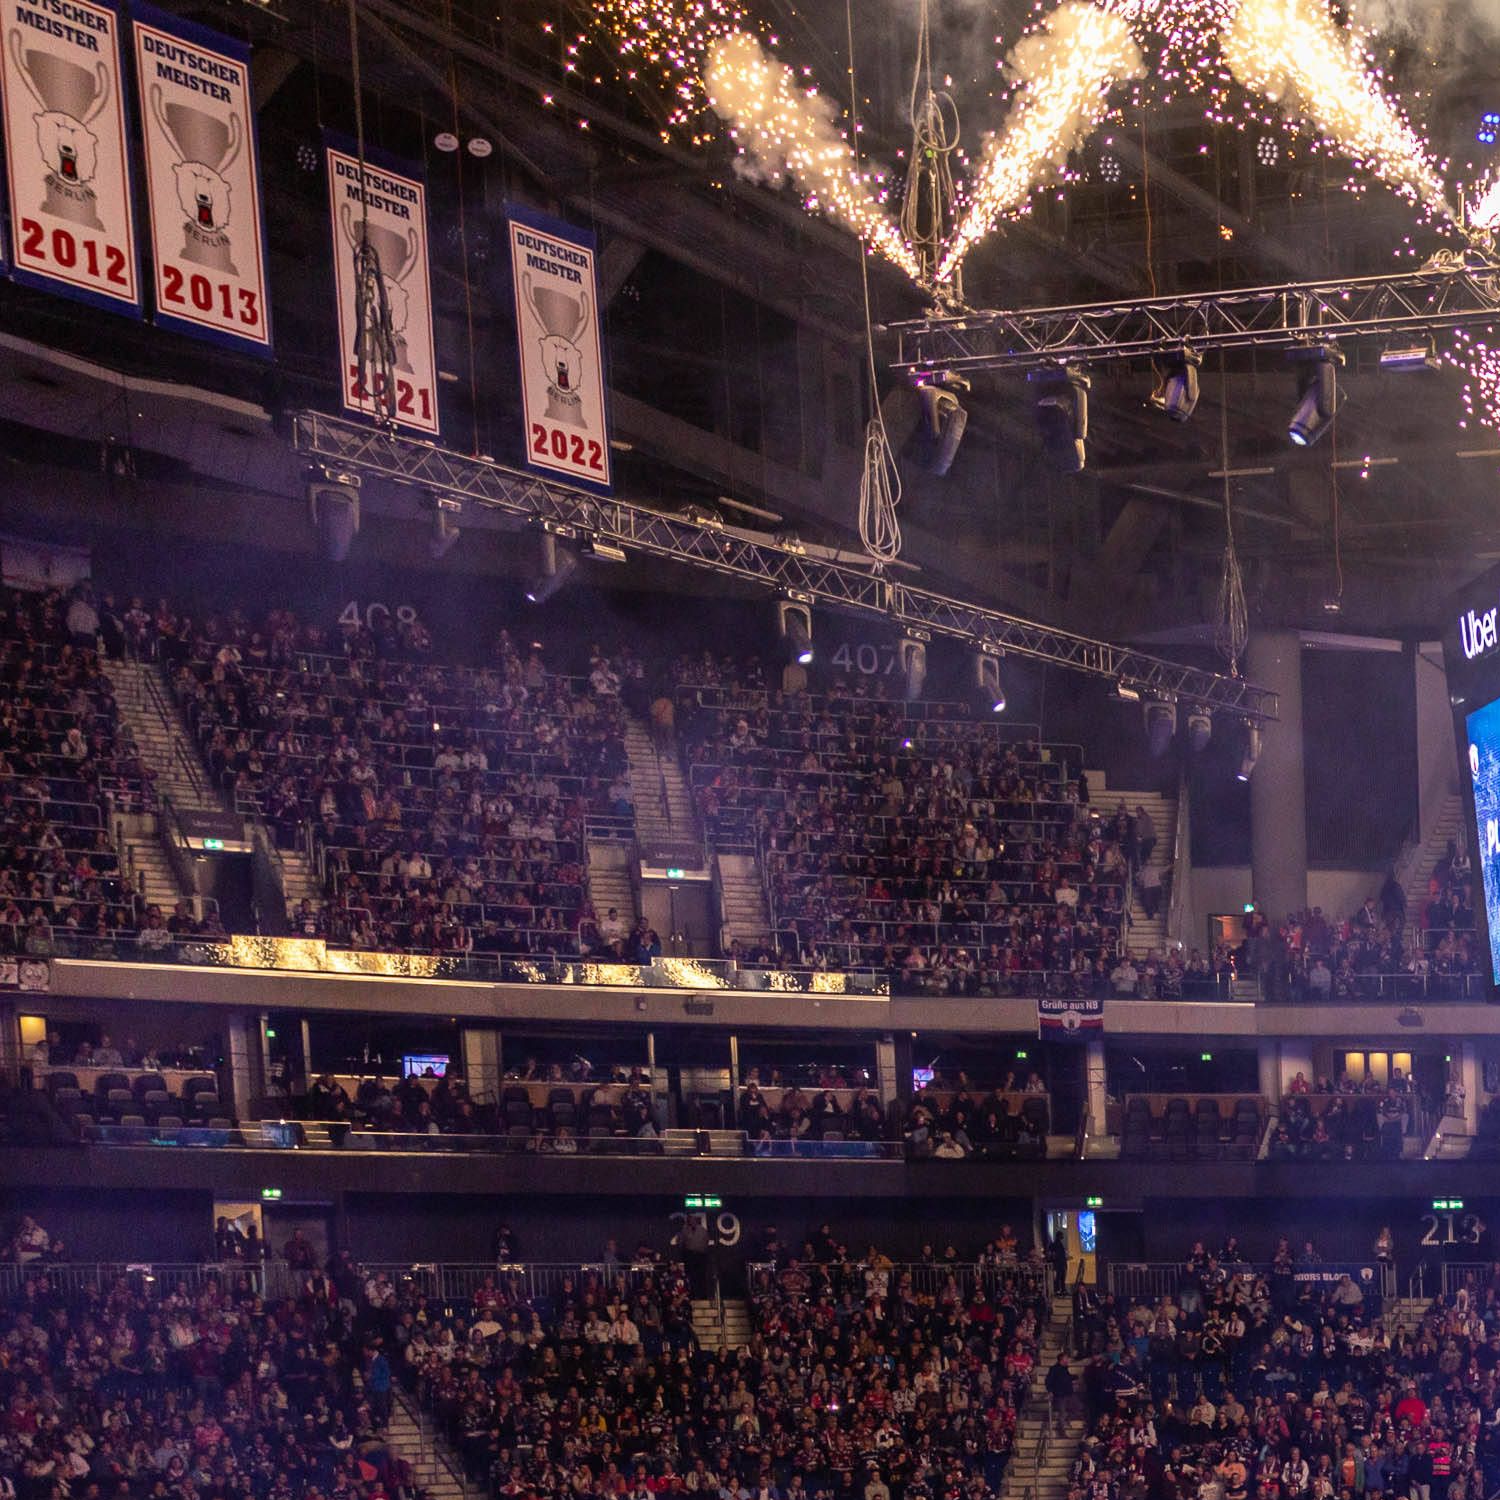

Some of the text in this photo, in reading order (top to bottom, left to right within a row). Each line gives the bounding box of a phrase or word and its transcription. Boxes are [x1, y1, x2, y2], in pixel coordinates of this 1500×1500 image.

[16, 7, 99, 51] MEISTER
[143, 35, 241, 86] DEUTSCHER
[156, 62, 232, 104] MEISTER
[44, 174, 99, 202] BERLIN
[335, 160, 419, 204] DEUTSCHER
[346, 184, 410, 220] MEISTER
[21, 217, 127, 286] 2012
[182, 221, 231, 247] BERLIN
[516, 231, 589, 269] DEUTSCHER
[526, 252, 582, 285] MEISTER
[163, 264, 258, 326] 2013
[531, 423, 604, 471] 2022
[1460, 608, 1499, 660] Uber
[831, 643, 897, 675] 407
[1041, 1000, 1099, 1010] Grüße aus NB
